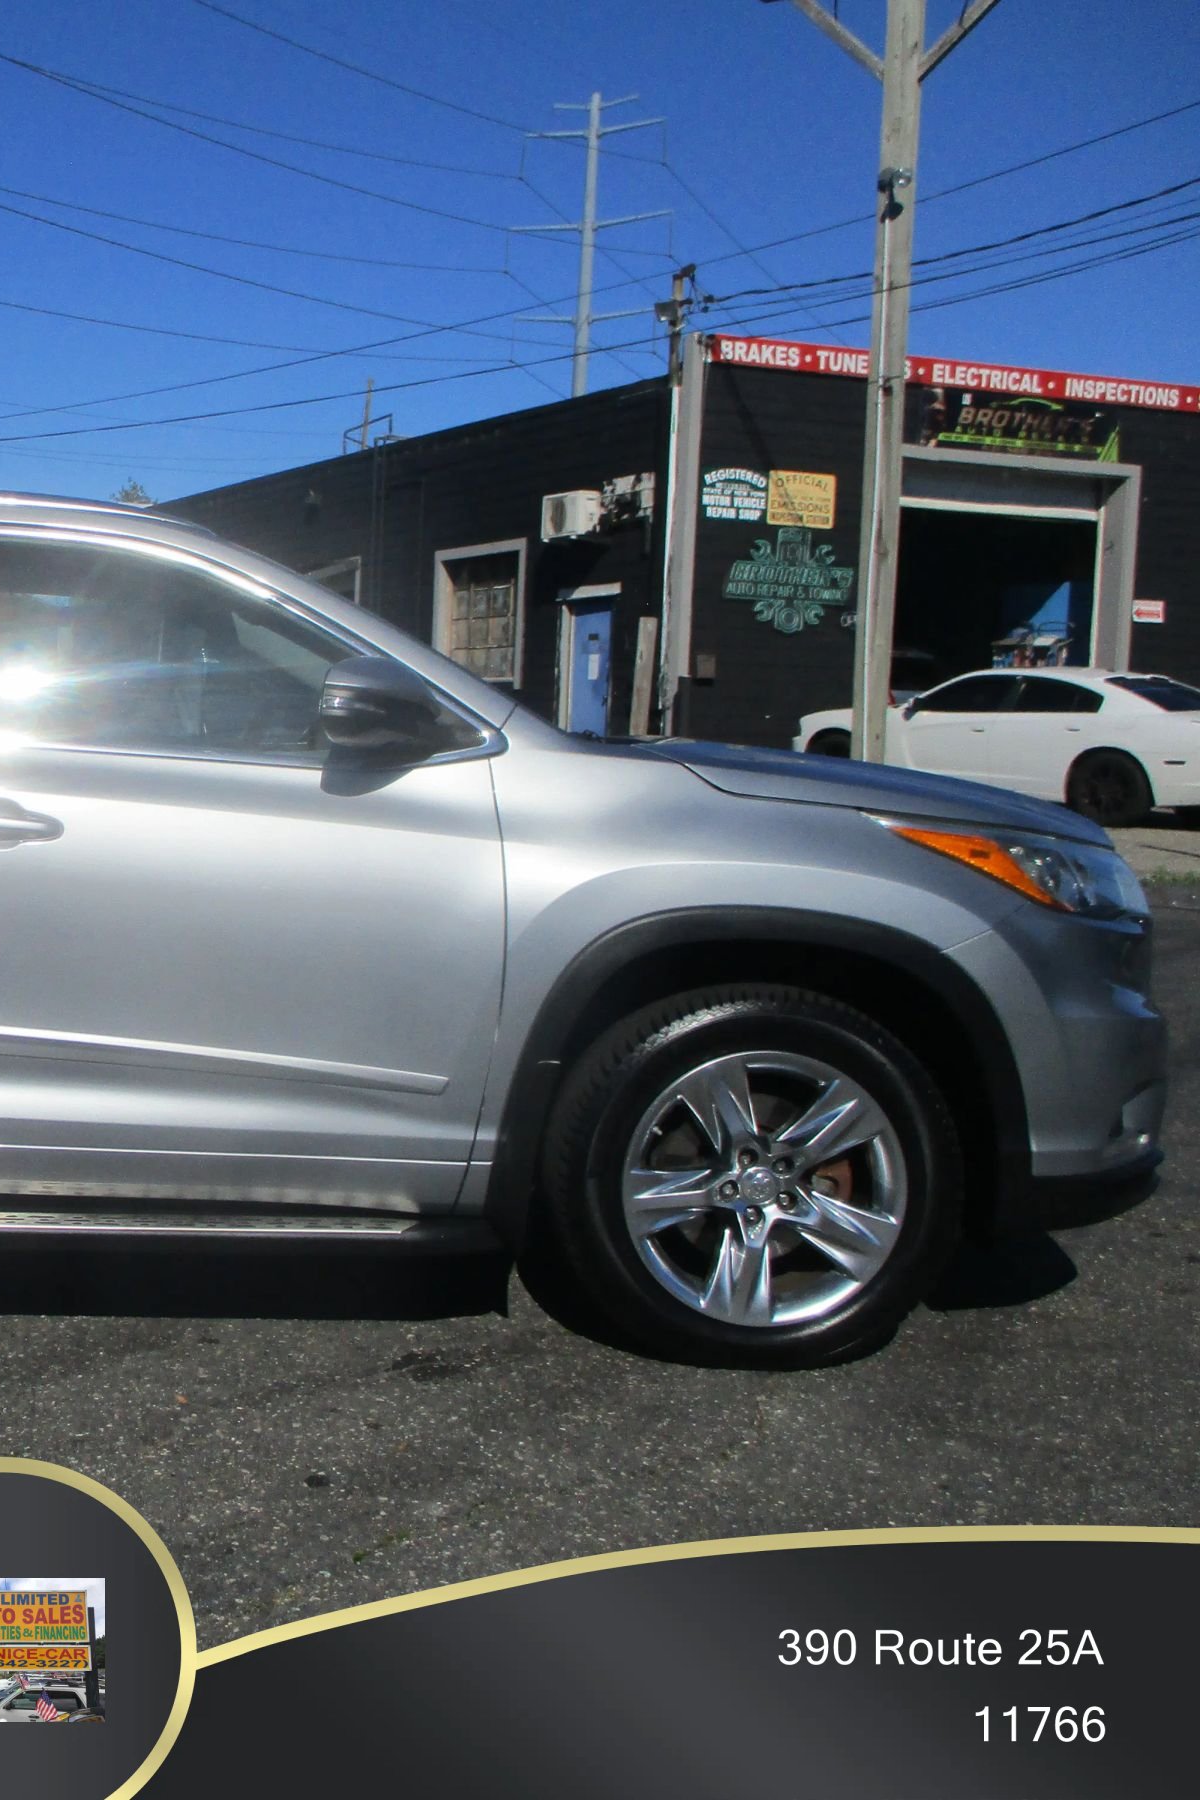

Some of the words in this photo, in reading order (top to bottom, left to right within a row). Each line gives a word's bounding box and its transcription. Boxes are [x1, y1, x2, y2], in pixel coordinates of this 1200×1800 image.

[720, 339, 800, 367] BRAKES
[932, 363, 1042, 394] ELECTRICAL
[1065, 378, 1180, 408] INSPECTIONS
[704, 468, 767, 489] REGISTERED
[776, 474, 829, 492] OFFICIAL
[702, 494, 732, 507] MOTOR
[733, 496, 767, 510] VEHICLE
[770, 499, 831, 514] EMISSIONS
[706, 506, 737, 519] REPAIR
[738, 508, 762, 521] SHOP
[726, 582, 755, 595] AUTO
[756, 583, 795, 598] REPAIR
